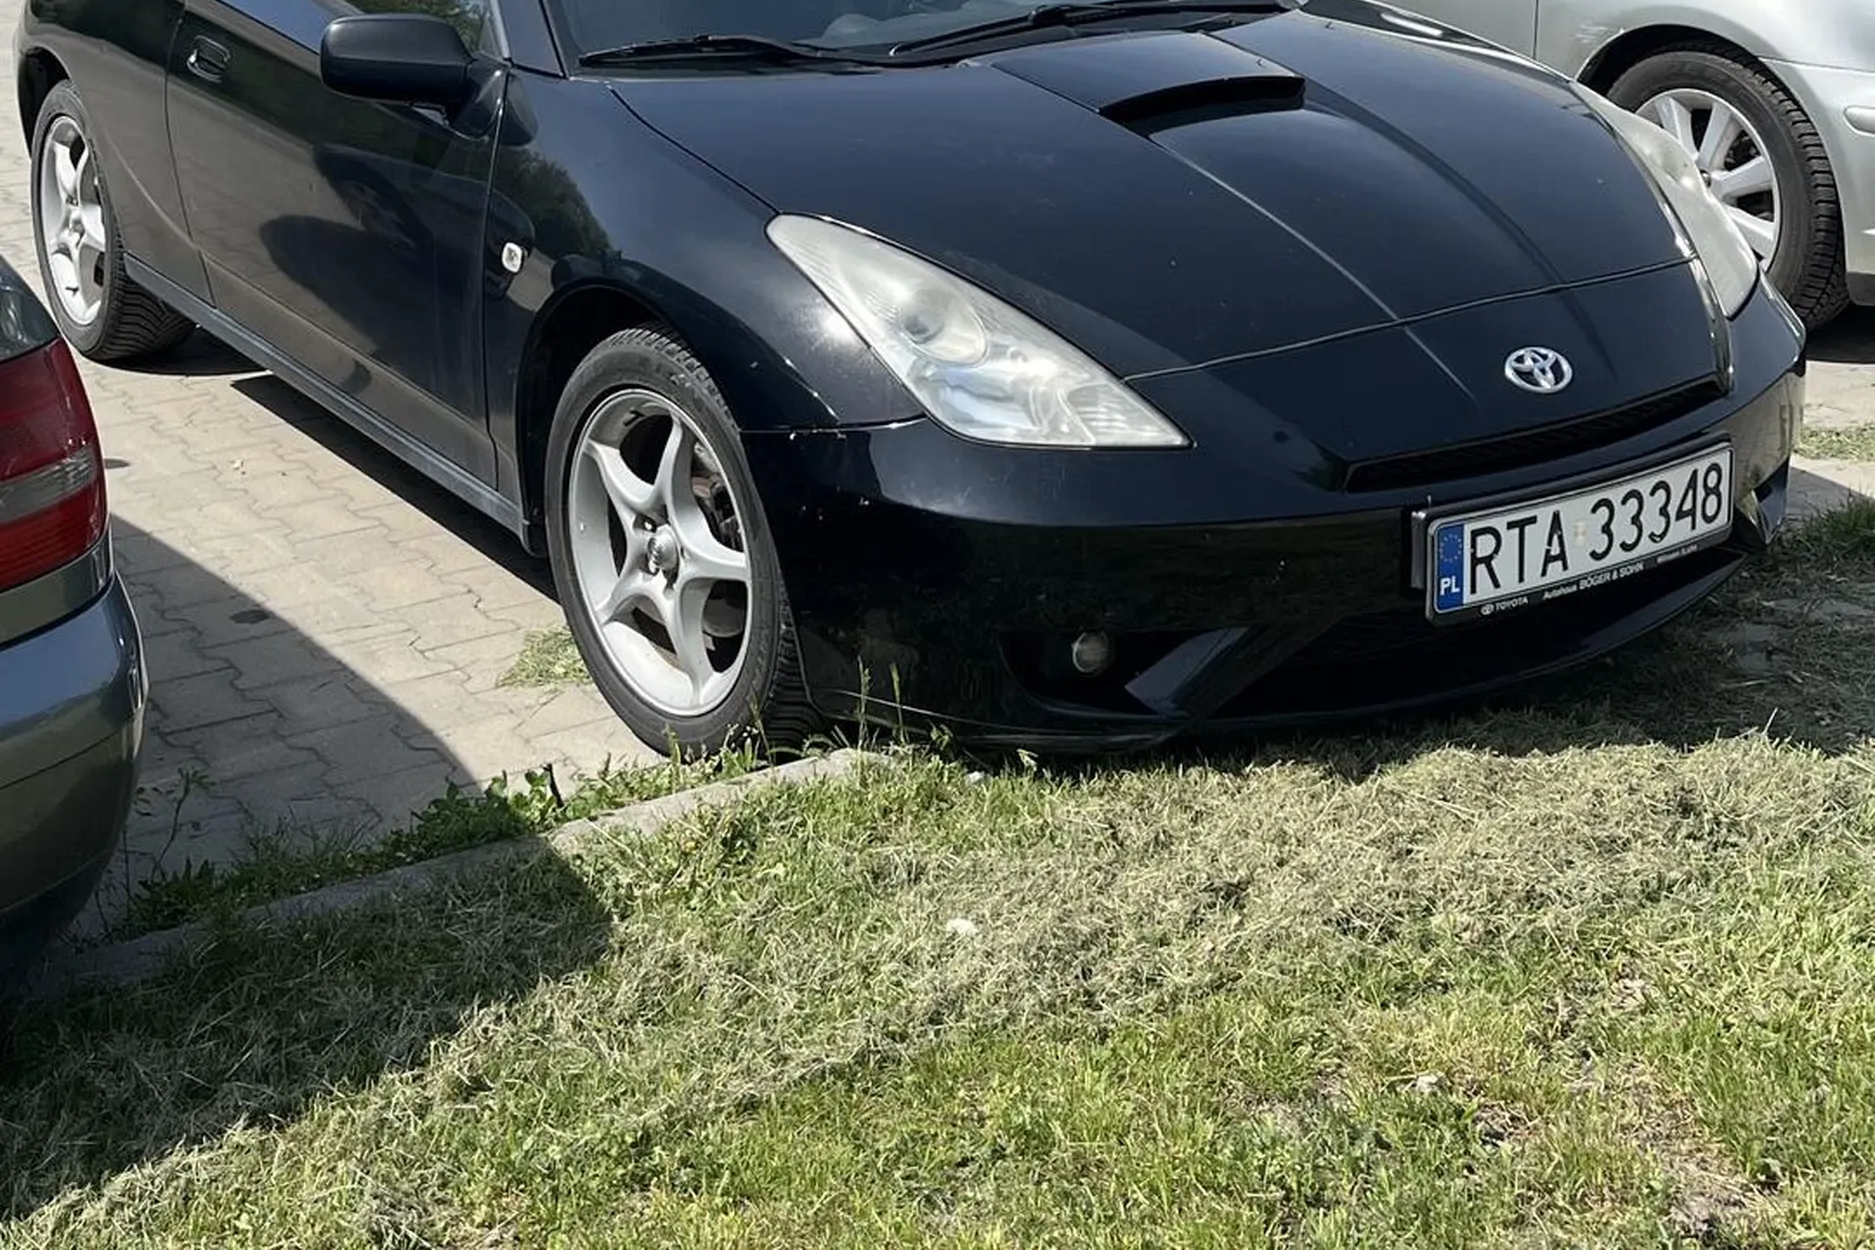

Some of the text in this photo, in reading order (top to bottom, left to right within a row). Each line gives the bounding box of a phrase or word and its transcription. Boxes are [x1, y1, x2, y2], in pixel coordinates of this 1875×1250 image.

[1469, 462, 1723, 595] RTA 33348
[1440, 575, 1461, 596] PL
[1495, 597, 1529, 612] TOYOTA
